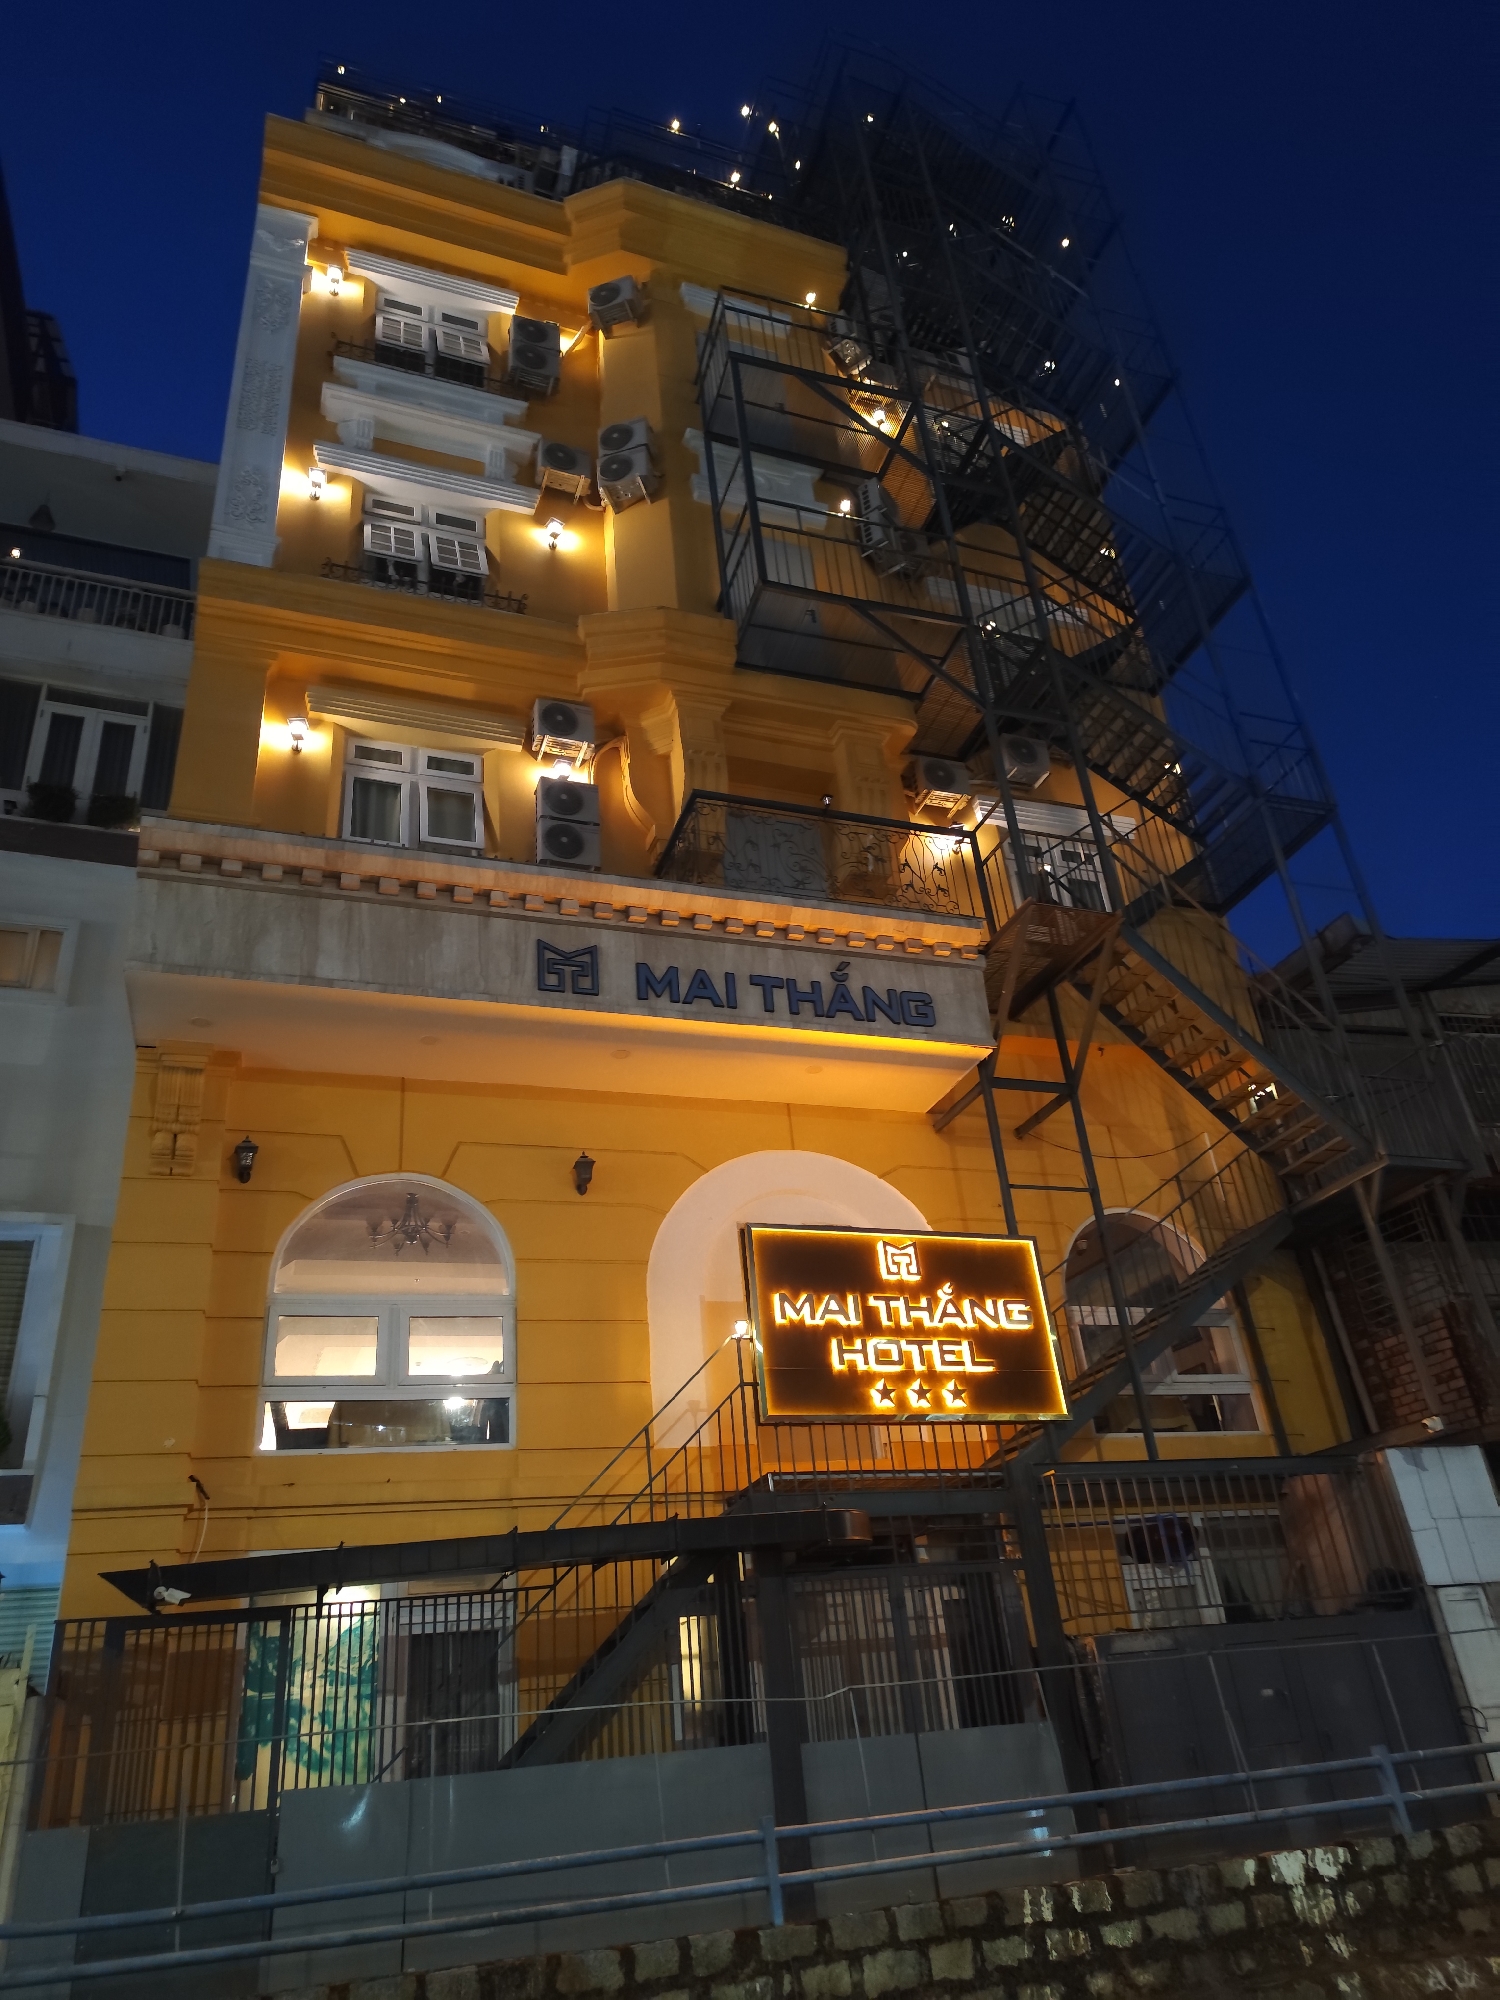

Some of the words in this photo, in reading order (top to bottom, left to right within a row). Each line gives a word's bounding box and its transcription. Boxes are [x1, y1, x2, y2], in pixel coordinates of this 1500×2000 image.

[636, 962, 738, 1009] MAI
[749, 961, 937, 1027] THẮNG
[773, 1291, 862, 1326] MAI
[869, 1283, 1034, 1329] THẮNG
[832, 1338, 996, 1373] HOTEL
